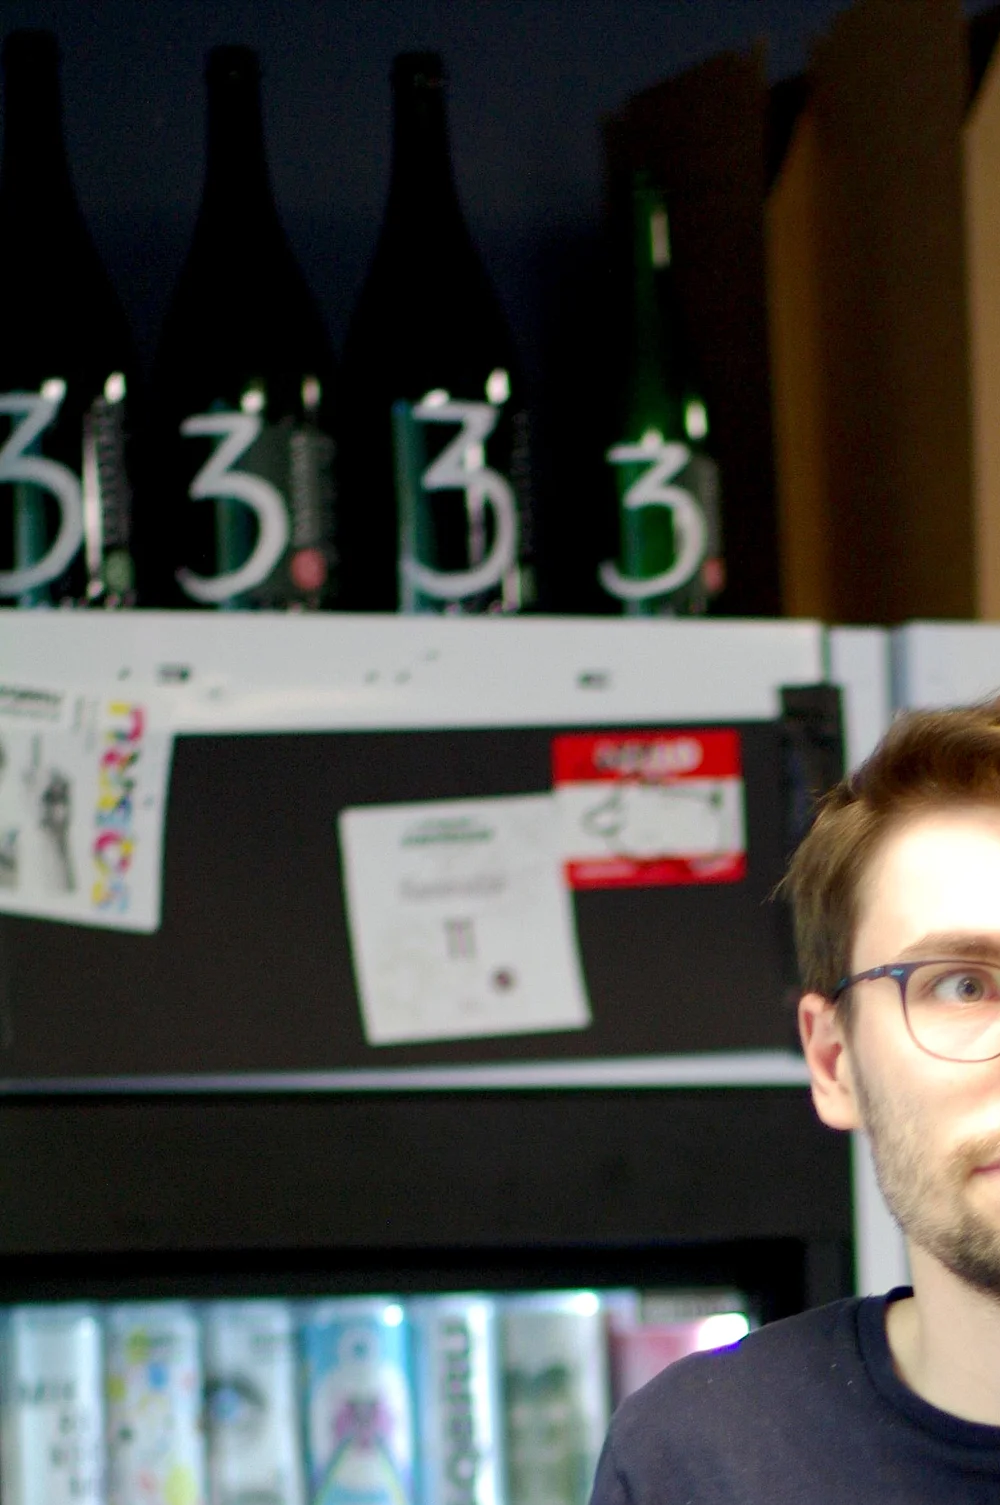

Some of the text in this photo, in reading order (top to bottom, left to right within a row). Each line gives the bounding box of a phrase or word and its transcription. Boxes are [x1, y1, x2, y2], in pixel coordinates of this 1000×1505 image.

[0, 389, 84, 597] 3
[175, 411, 289, 602] 3
[401, 401, 518, 599] 3
[599, 440, 705, 599] 3
